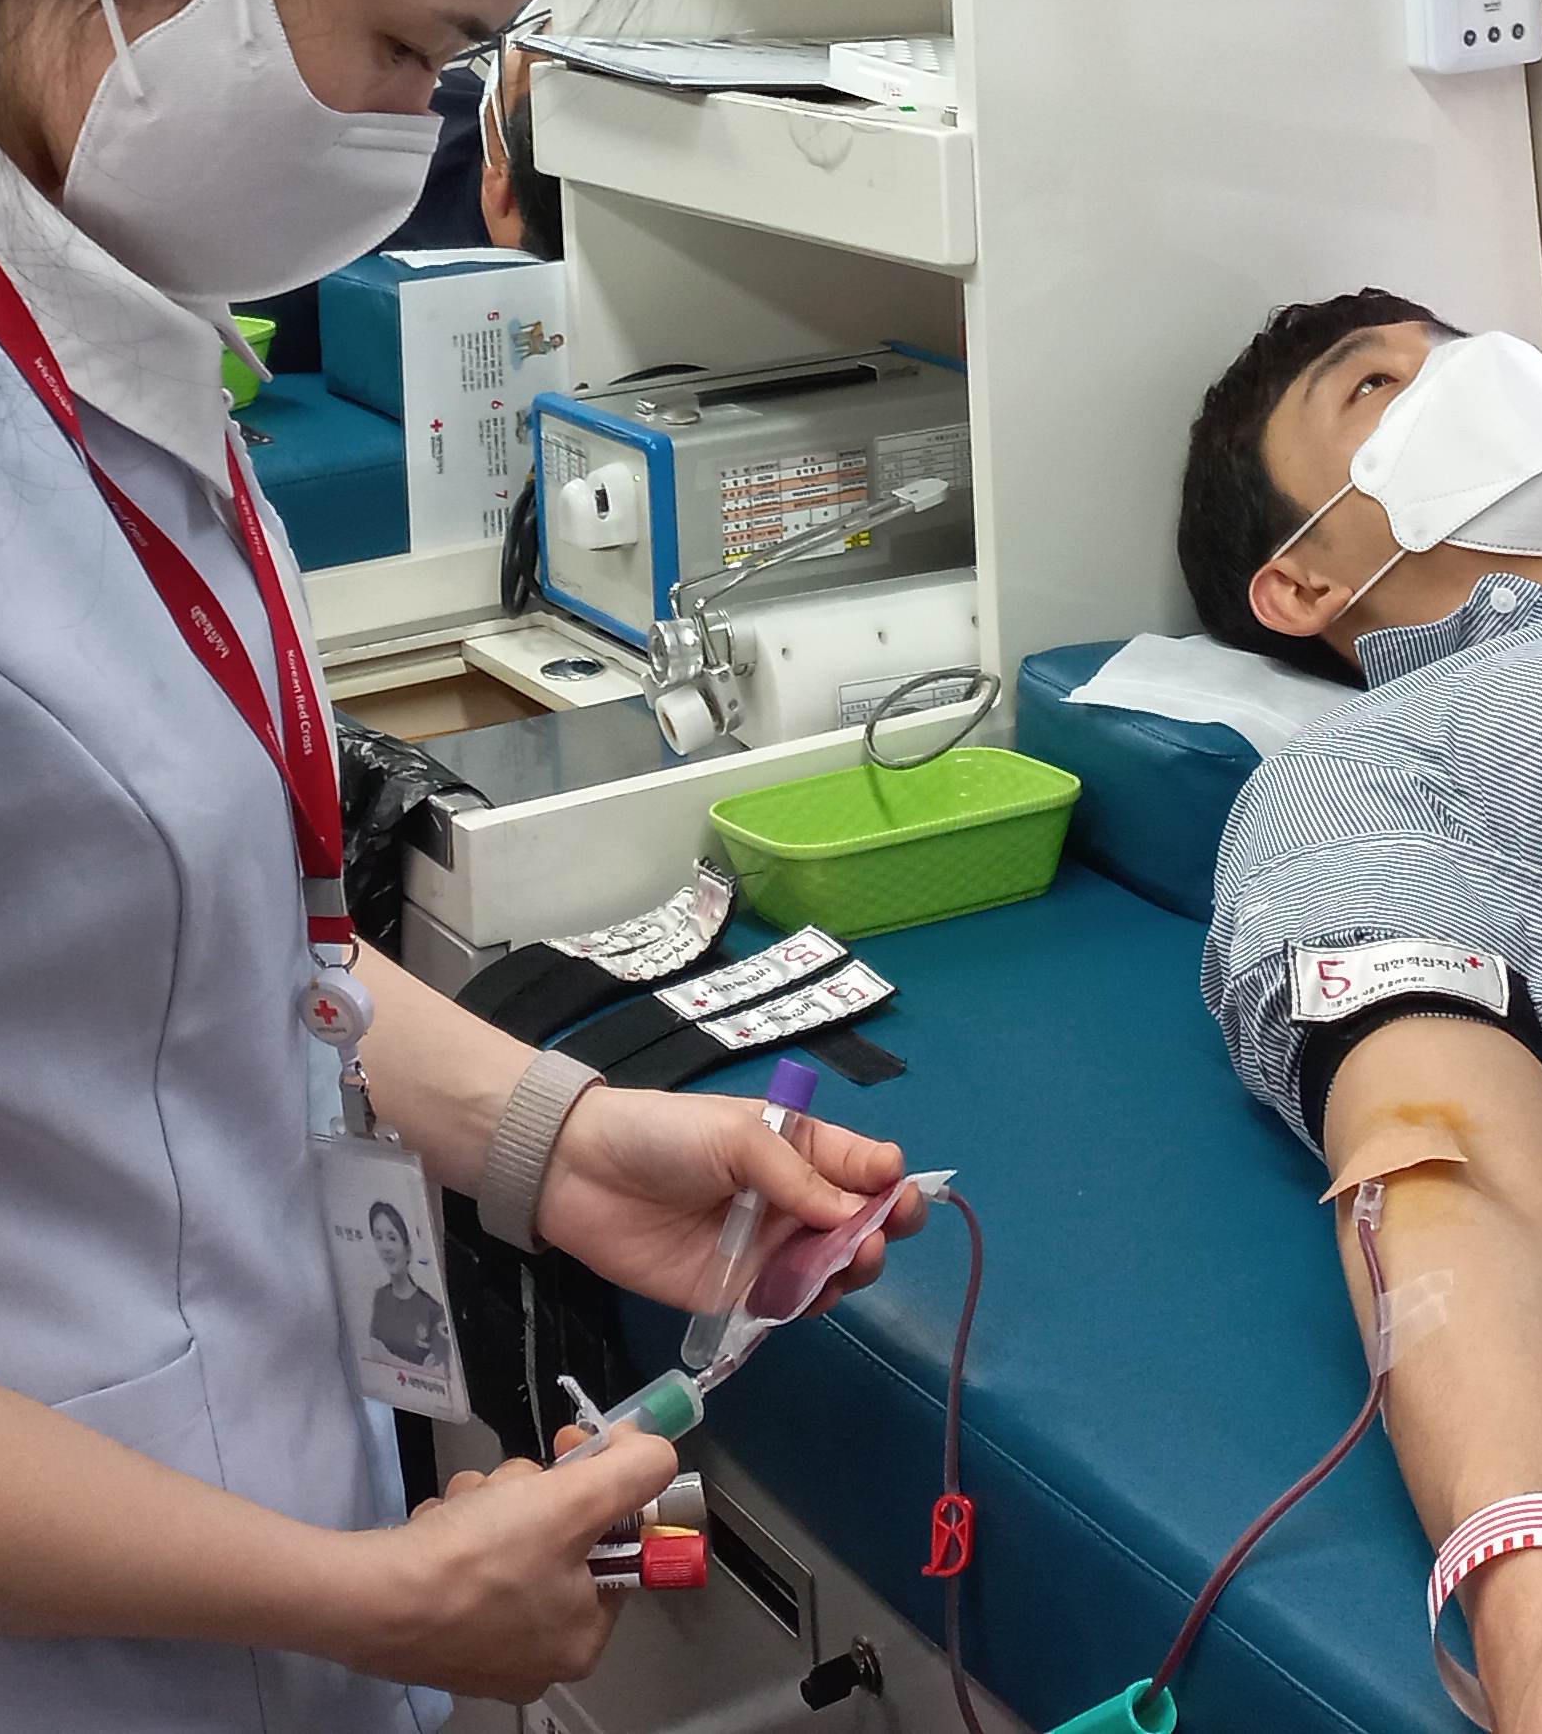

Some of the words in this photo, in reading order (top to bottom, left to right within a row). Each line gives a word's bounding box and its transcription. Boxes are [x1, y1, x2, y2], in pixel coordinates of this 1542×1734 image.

[286, 648, 302, 694] Korean
[295, 694, 311, 720] Red
[300, 718, 314, 756] Cross
[1317, 960, 1352, 999] 5
[1374, 956, 1467, 974] 대한적십자사
